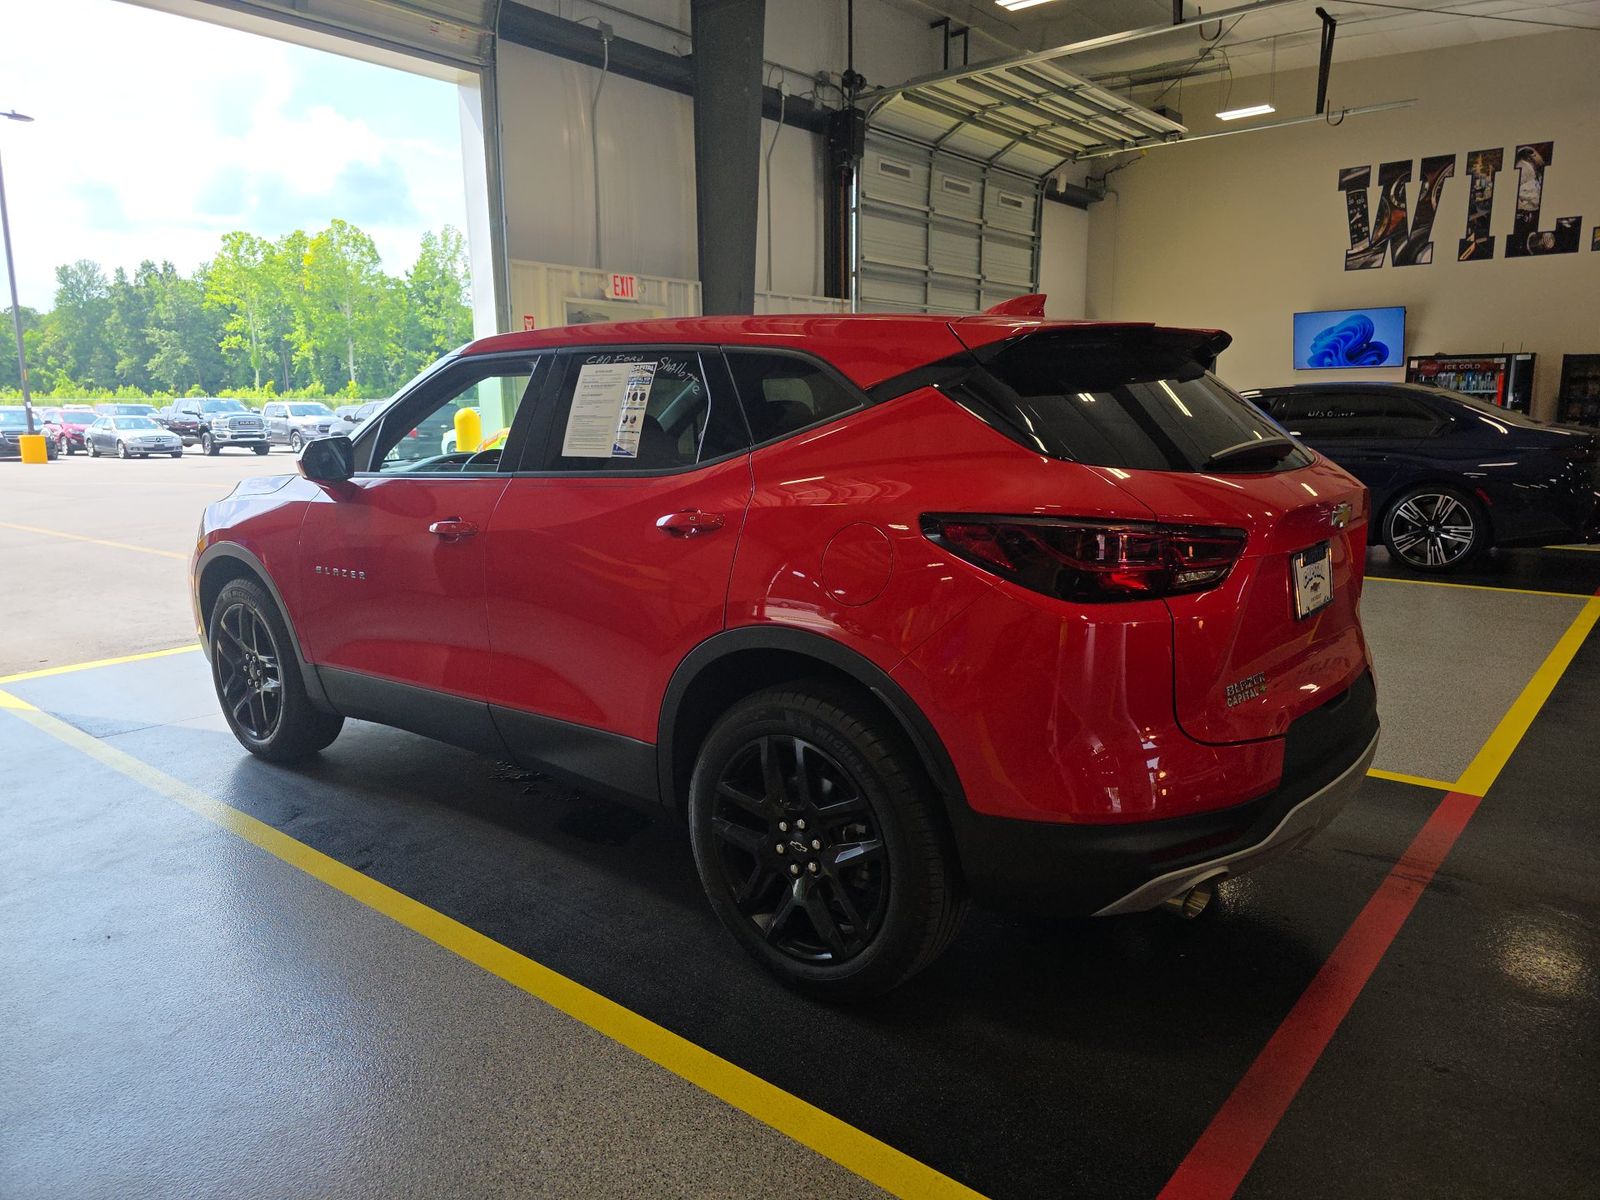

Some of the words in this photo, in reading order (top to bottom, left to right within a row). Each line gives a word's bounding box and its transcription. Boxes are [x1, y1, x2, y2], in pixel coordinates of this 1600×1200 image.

[1338, 141, 1600, 272] WIL
[612, 274, 635, 298] EXIT
[315, 565, 366, 580] BLAZER
[1226, 672, 1265, 696] BLAZER
[1227, 688, 1259, 707] CAPITAL
